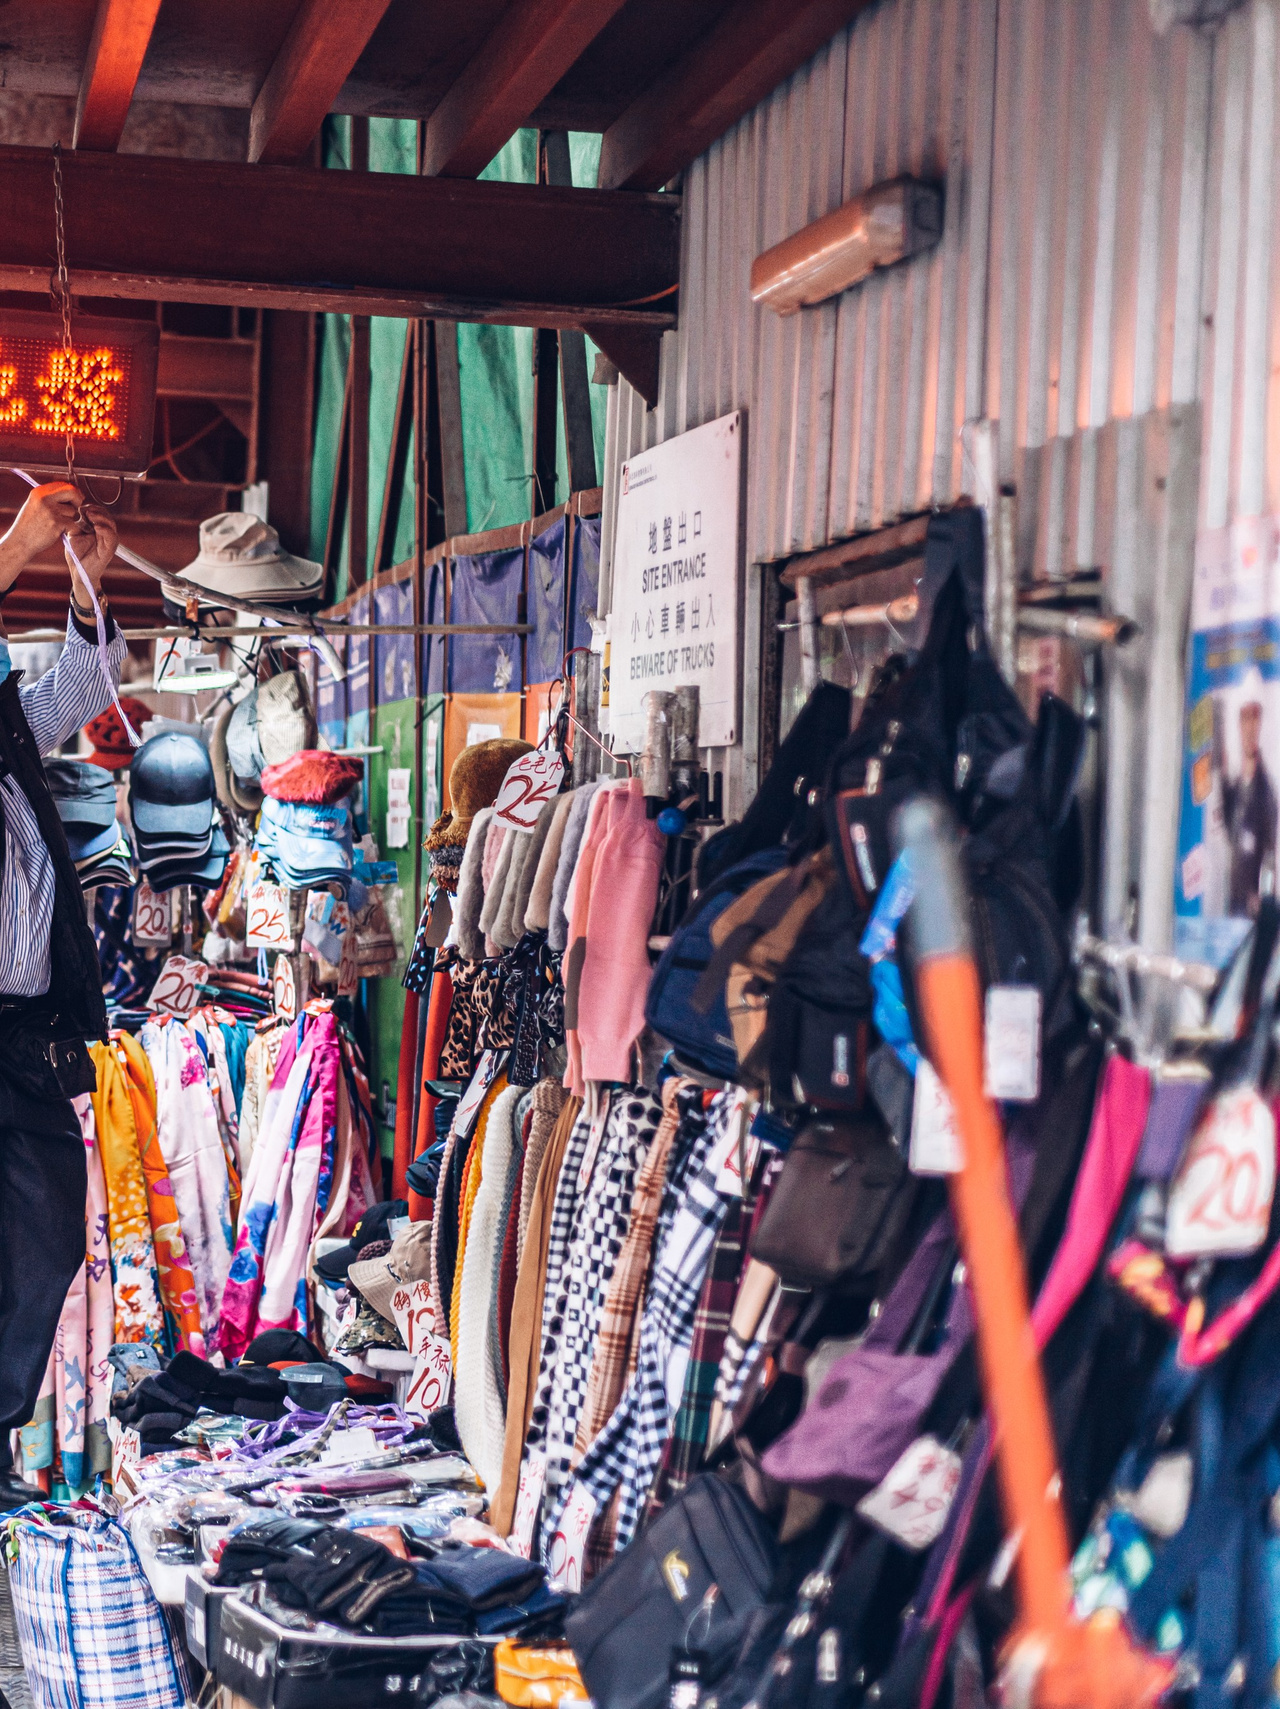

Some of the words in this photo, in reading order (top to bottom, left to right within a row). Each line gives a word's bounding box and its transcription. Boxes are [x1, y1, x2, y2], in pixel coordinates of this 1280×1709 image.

[648, 510, 701, 555] 地盤出口
[642, 565, 659, 594] SITE
[661, 552, 706, 589] ENTRANCE
[631, 593, 715, 643] 小心車輛出入
[630, 651, 665, 681] BEWARE
[667, 648, 679, 675] OF
[680, 641, 715, 673] TRUCKS
[496, 774, 557, 828] 25
